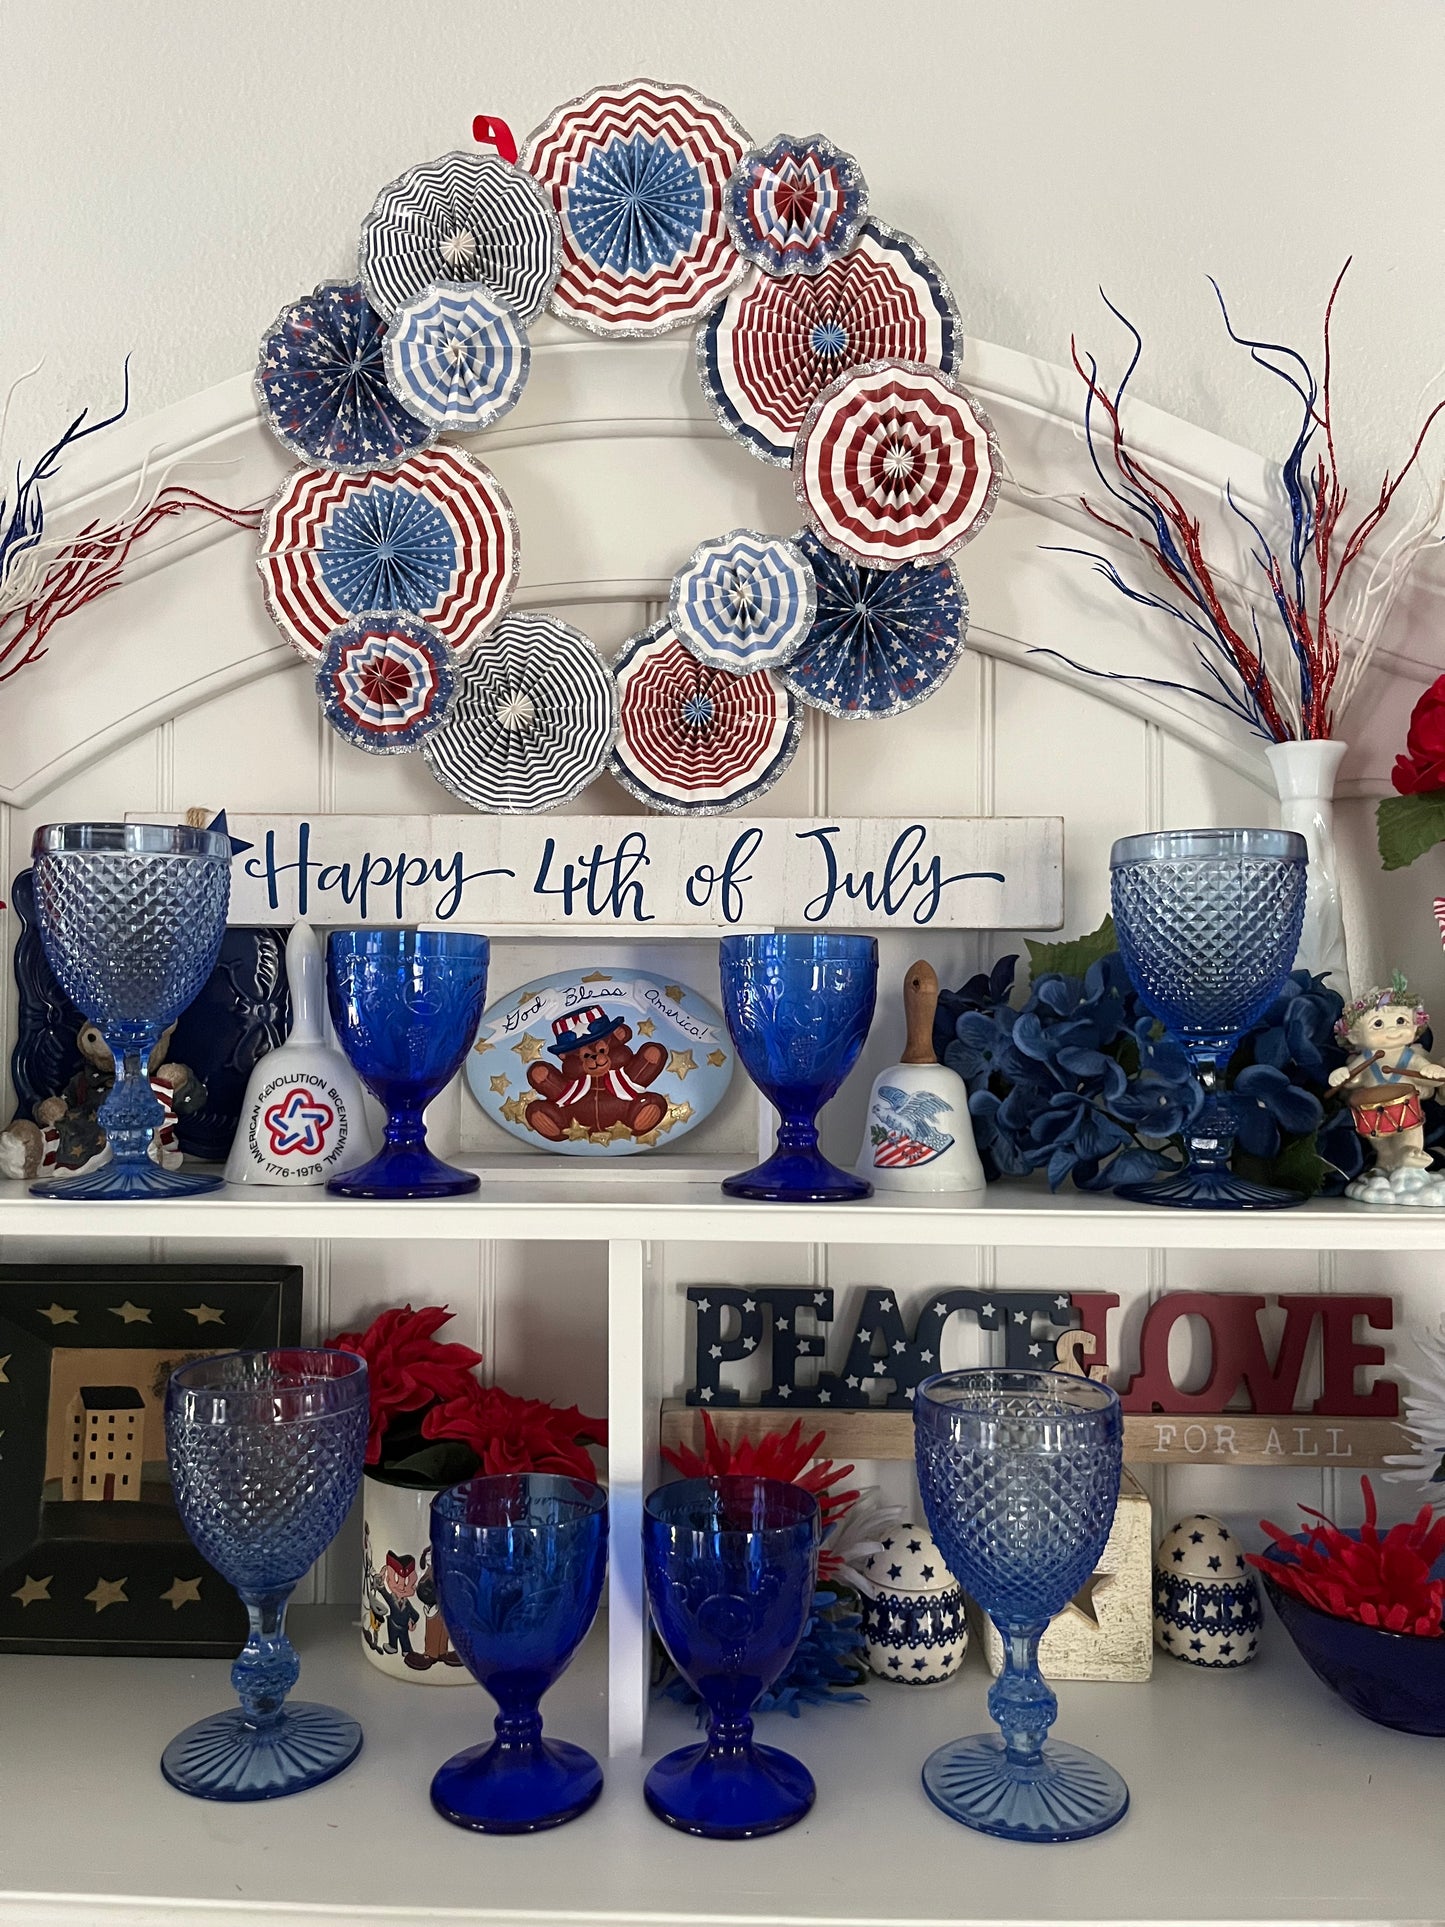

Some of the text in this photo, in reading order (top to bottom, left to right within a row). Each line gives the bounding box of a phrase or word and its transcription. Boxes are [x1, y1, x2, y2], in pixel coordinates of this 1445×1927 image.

[244, 821, 1006, 926] Happy 4th of July
[502, 996, 548, 1035] God
[562, 987, 628, 1008] Bless
[248, 1073, 348, 1165] AMERICAN REVOLUTION BICENTENNIAL
[265, 1162, 323, 1178] 1776-1976
[686, 1287, 1072, 1409] PEACE
[1050, 1329, 1110, 1384] &
[1153, 1424, 1353, 1457] FOR ALL
